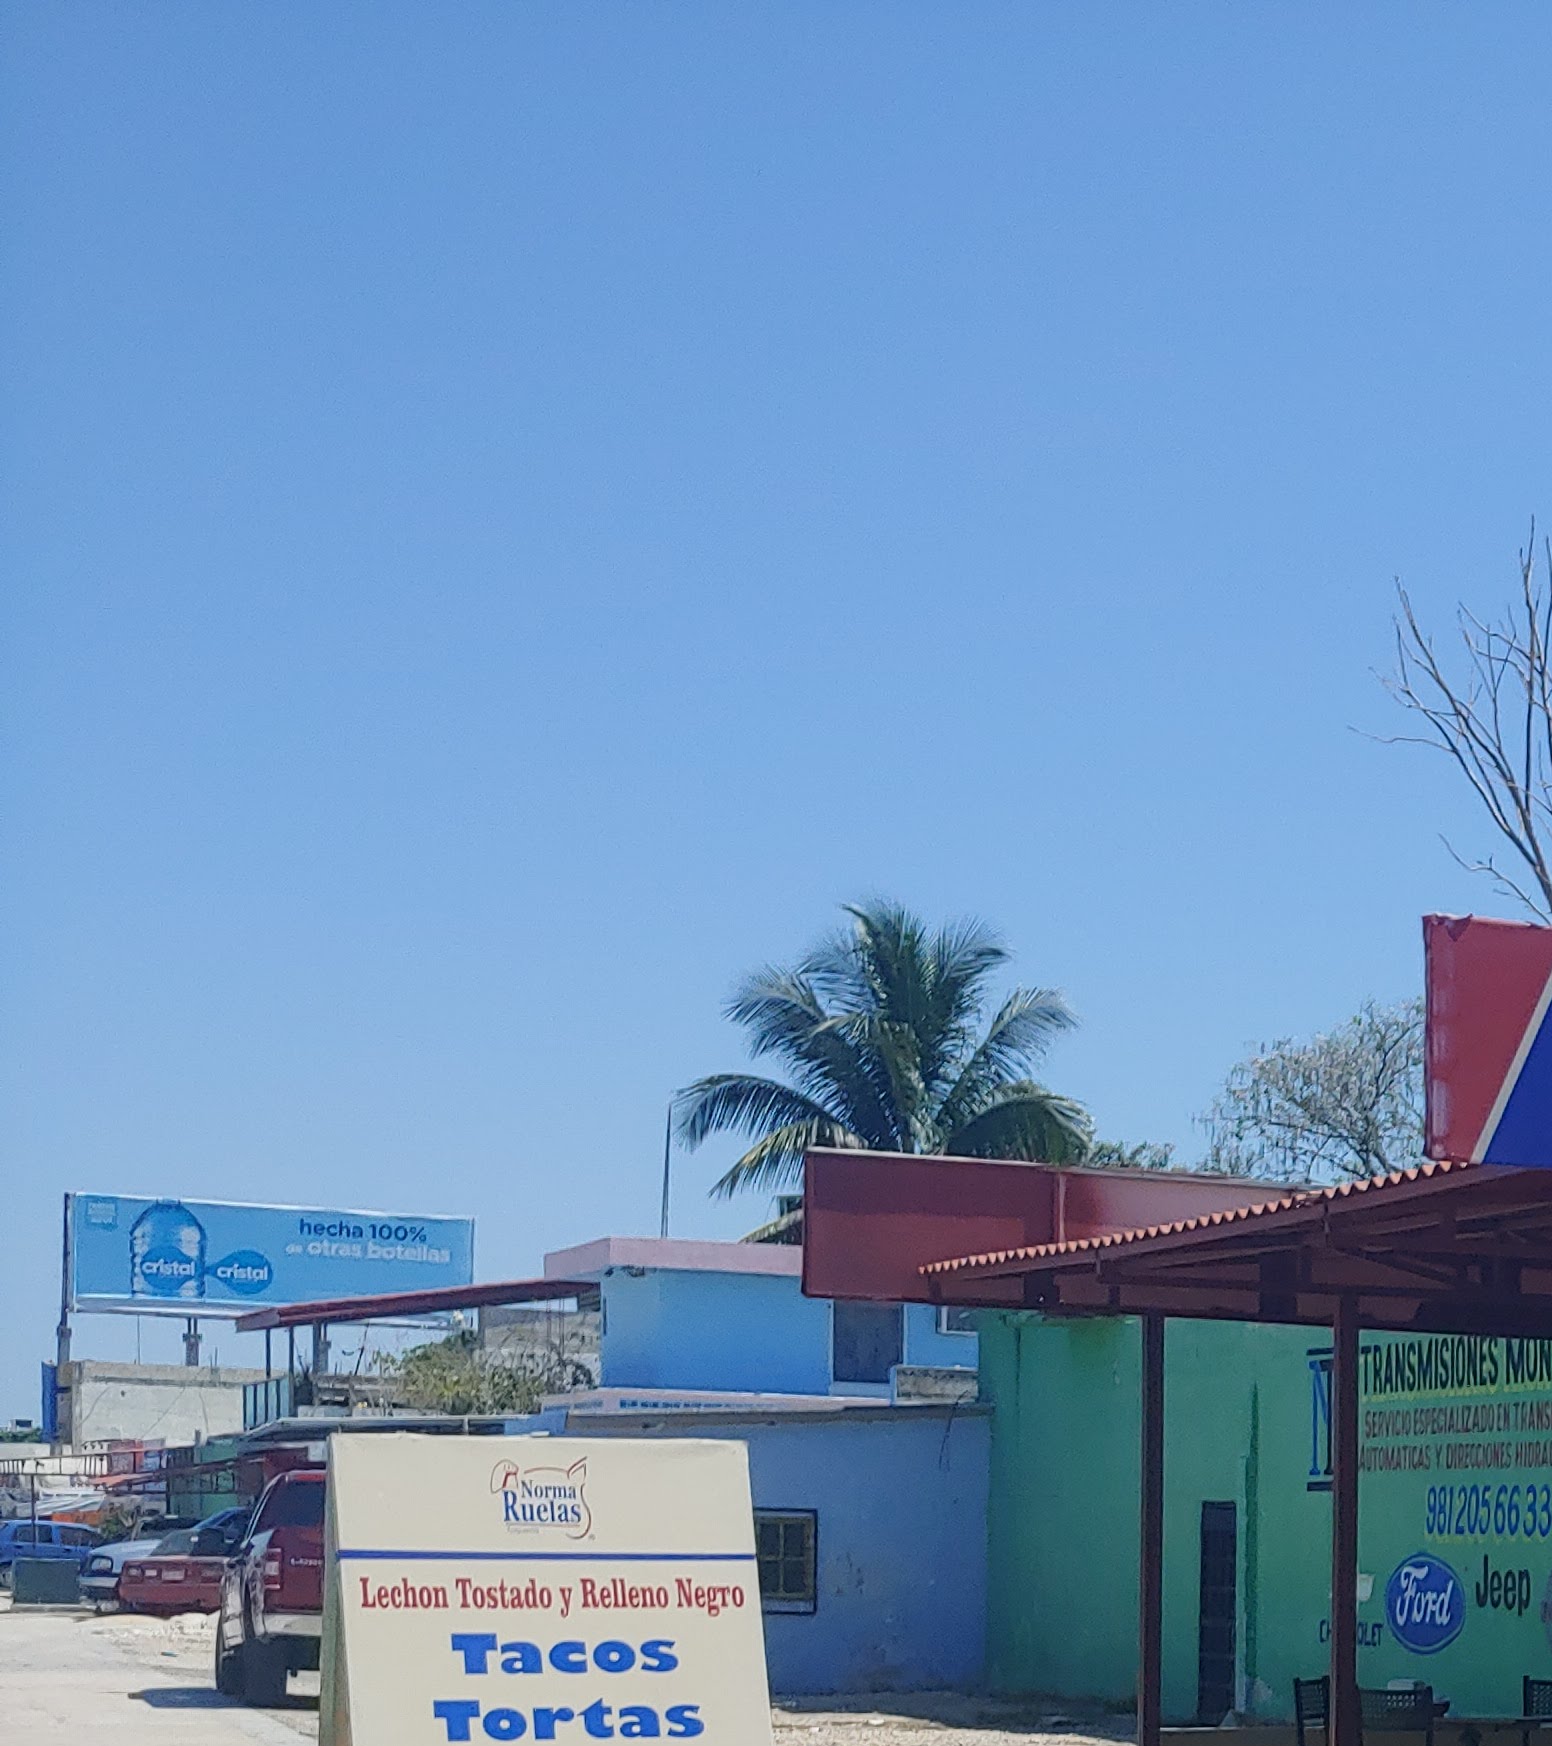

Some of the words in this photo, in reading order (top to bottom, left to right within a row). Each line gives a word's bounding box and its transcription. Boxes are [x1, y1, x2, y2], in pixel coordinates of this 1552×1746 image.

[299, 1218, 364, 1238] hecha
[368, 1223, 427, 1243] 100%
[141, 1258, 196, 1277] cristal
[307, 1240, 362, 1258] otras
[366, 1241, 451, 1263] botellas
[216, 1263, 269, 1282] cristal
[1360, 1337, 1500, 1395] TRANSMISIONES
[1364, 1409, 1411, 1438] SERVICIO
[1413, 1402, 1496, 1435] ESPECIALIZADO
[1497, 1401, 1511, 1432] EN
[1358, 1444, 1431, 1472] AUTOMATICAS
[1435, 1444, 1443, 1470] Y
[1445, 1442, 1512, 1470] DIRECCIONES
[503, 1489, 582, 1523] Ruelas
[521, 1479, 577, 1500] Norma
[360, 1576, 449, 1609] Lechon
[455, 1577, 553, 1610] Tostado
[560, 1586, 573, 1618] y
[580, 1577, 669, 1608] Relleno
[675, 1578, 745, 1617] Negro
[1395, 1564, 1455, 1627] Ford
[1476, 1554, 1531, 1616] Jeep
[451, 1632, 679, 1676] Tacos
[433, 1697, 705, 1742] Tortas
